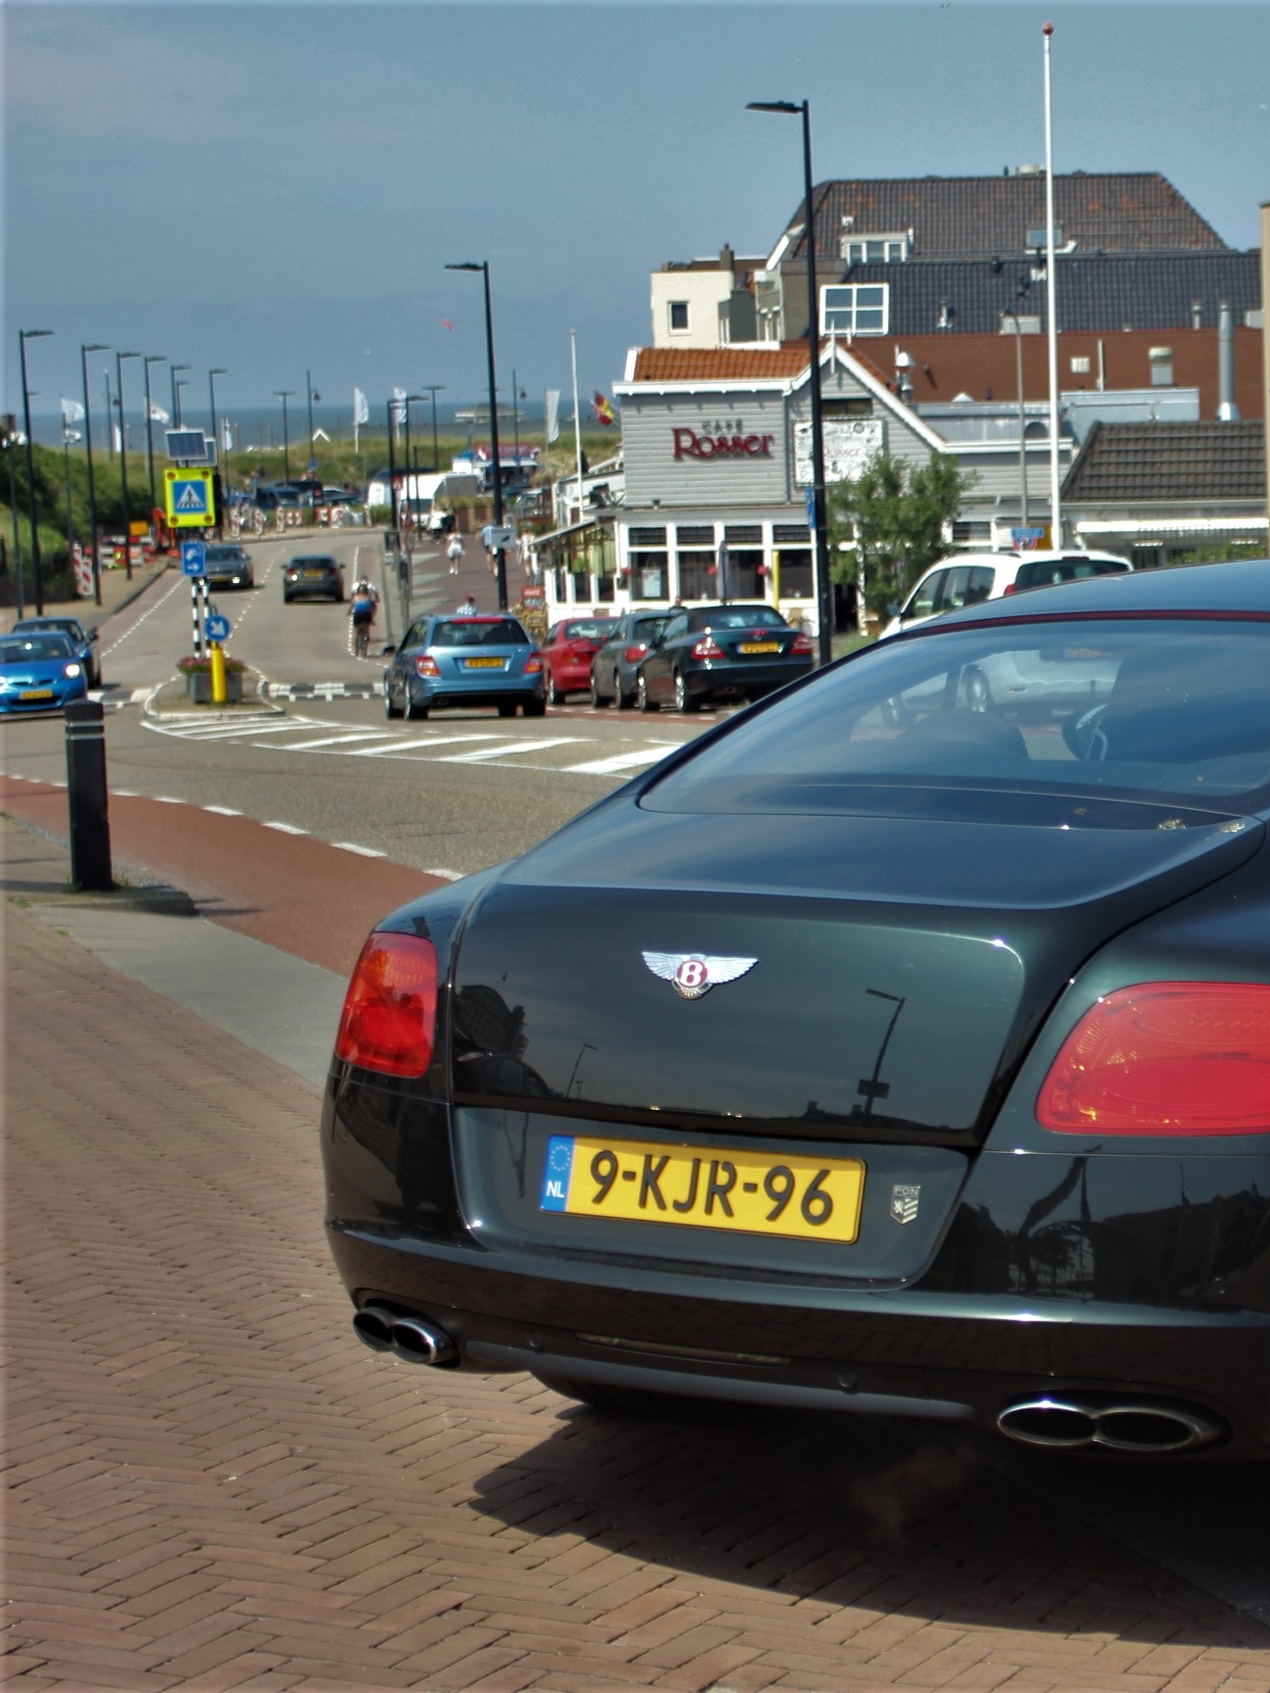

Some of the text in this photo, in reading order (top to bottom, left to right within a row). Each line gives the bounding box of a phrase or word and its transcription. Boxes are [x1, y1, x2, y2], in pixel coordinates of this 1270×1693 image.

[672, 428, 775, 459] Rosser
[546, 1180, 566, 1199] NL
[590, 1149, 833, 1226] 9-KJR-96
[895, 1187, 918, 1196] PON
